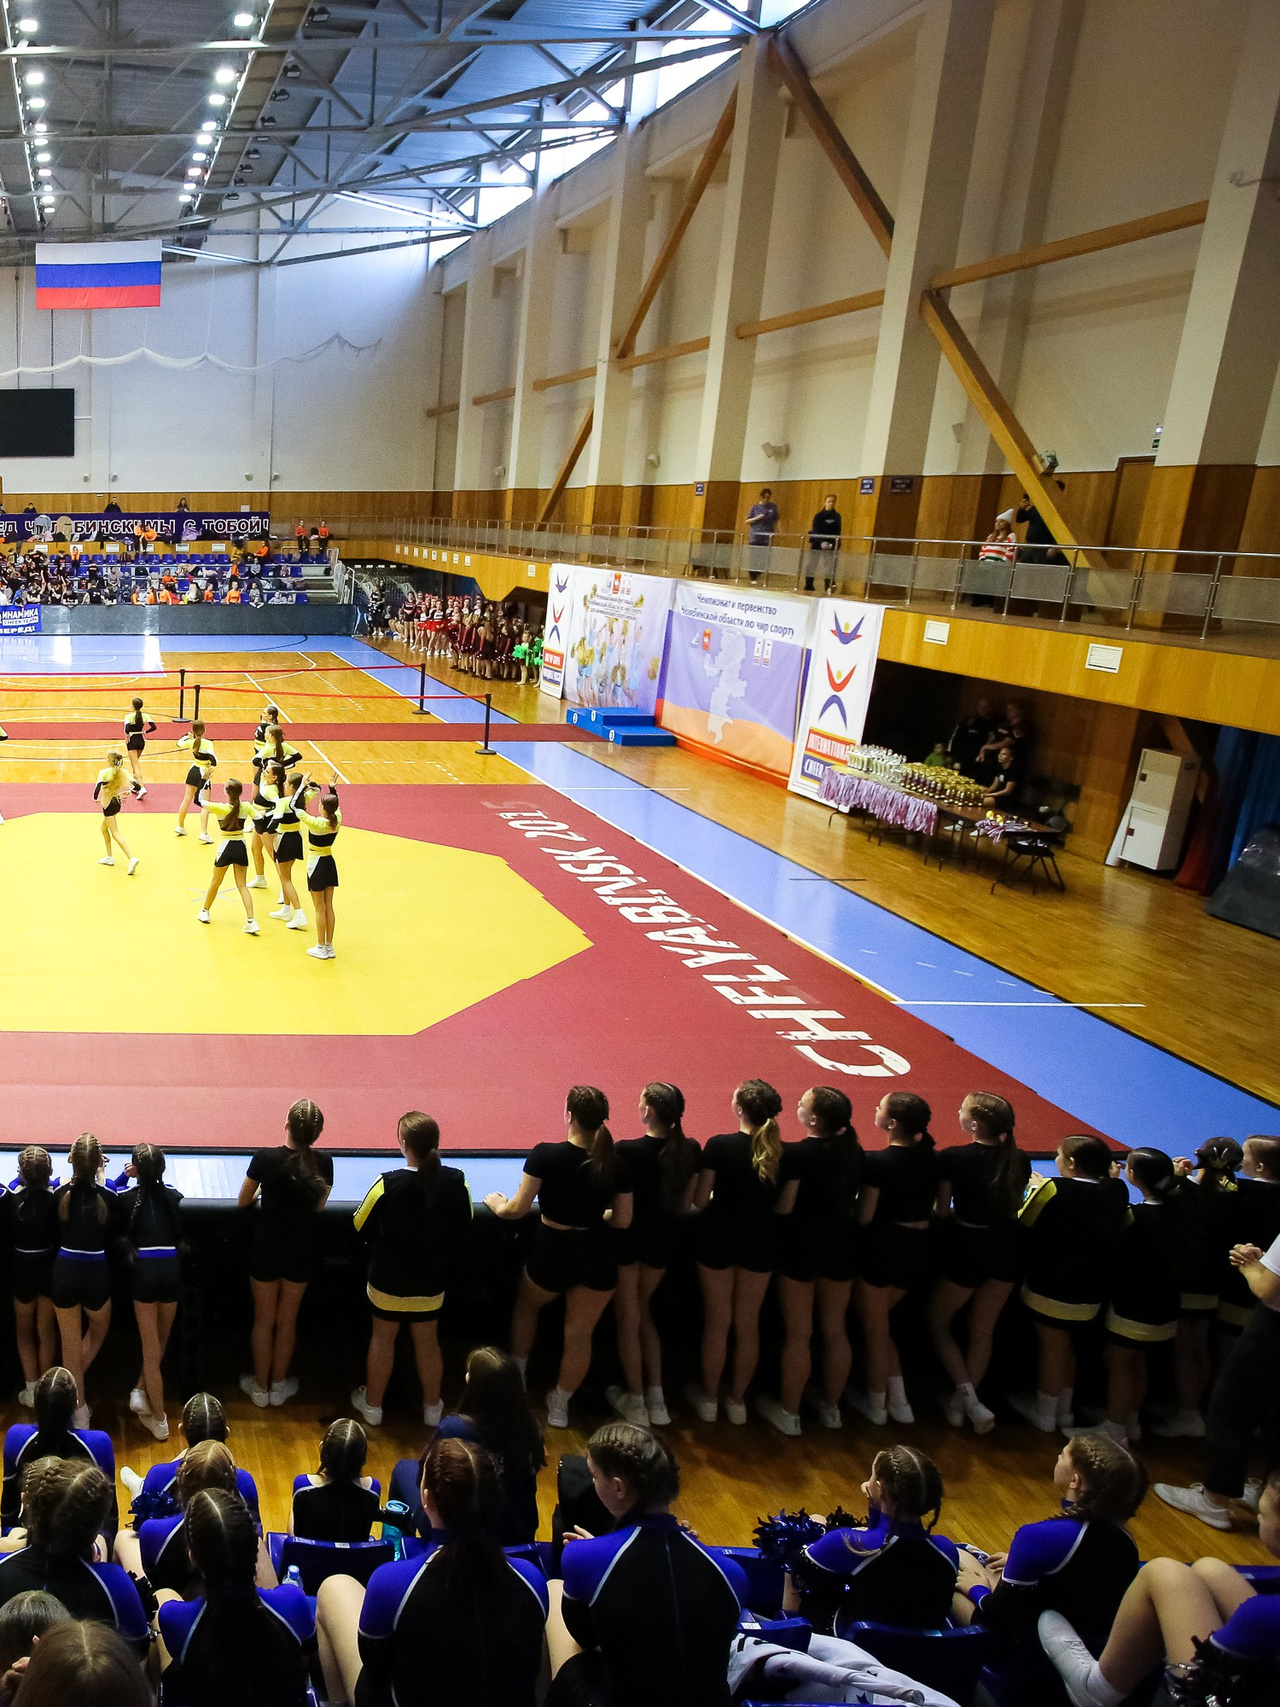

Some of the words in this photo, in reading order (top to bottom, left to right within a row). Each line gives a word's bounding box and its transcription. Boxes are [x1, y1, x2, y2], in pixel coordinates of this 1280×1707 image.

[737, 602, 777, 616] первенство
[718, 613, 744, 627] области
[745, 620, 755, 629] по
[770, 624, 795, 639] спорту
[540, 846, 912, 1077] CHELYABINSK
